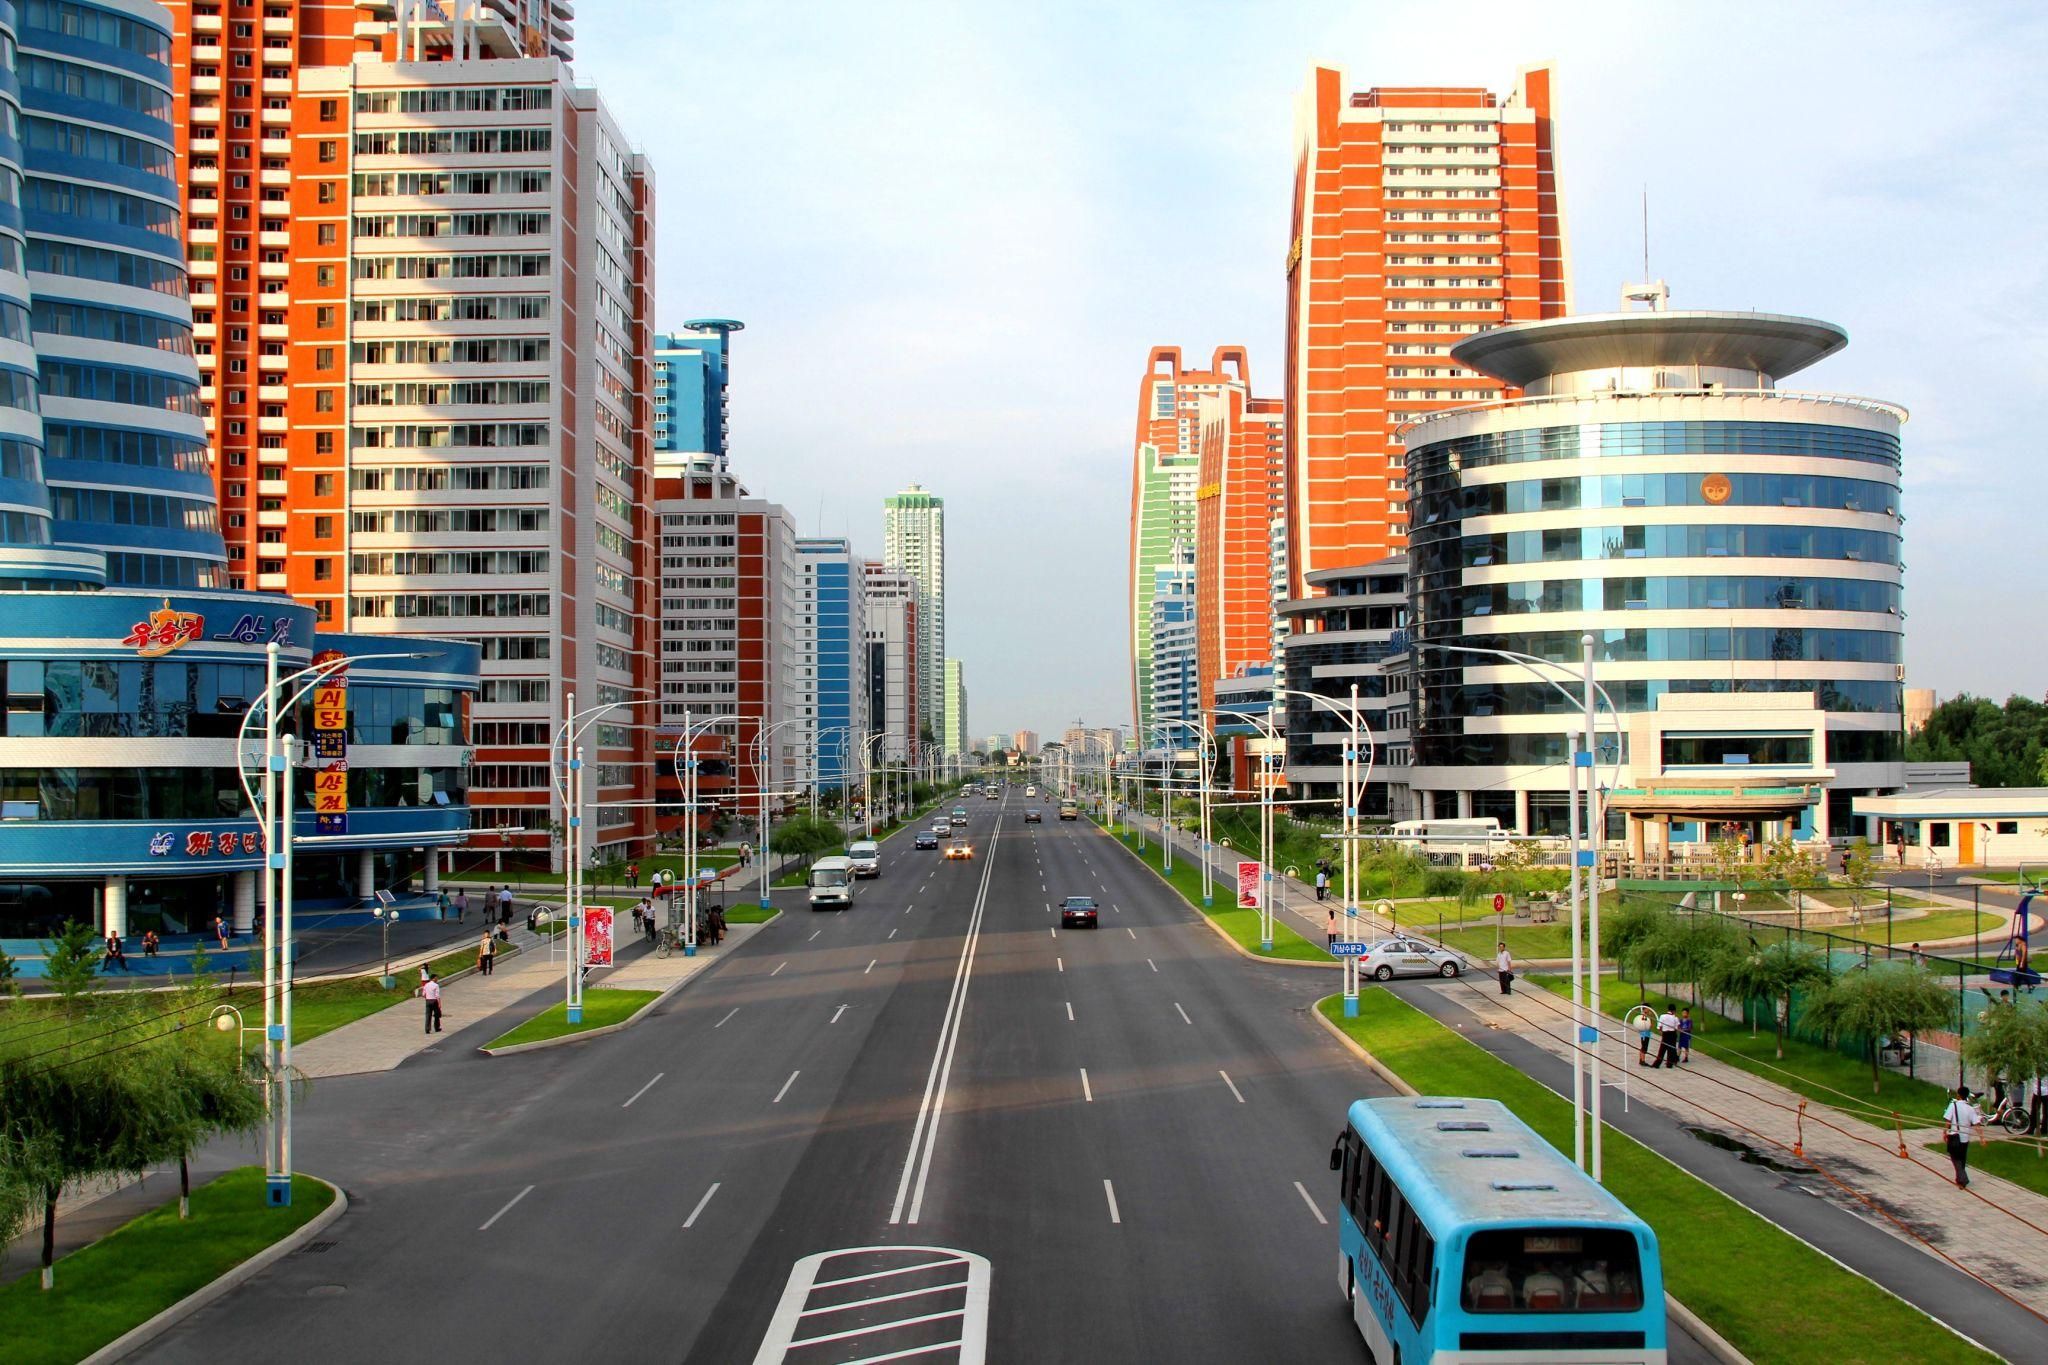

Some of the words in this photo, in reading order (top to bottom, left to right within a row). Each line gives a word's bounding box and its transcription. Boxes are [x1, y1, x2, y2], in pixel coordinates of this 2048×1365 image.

[122, 615, 205, 647] 우승컵
[213, 613, 296, 647] 상점
[317, 774, 345, 810] 상점
[1332, 944, 1362, 954] 기상수문국
